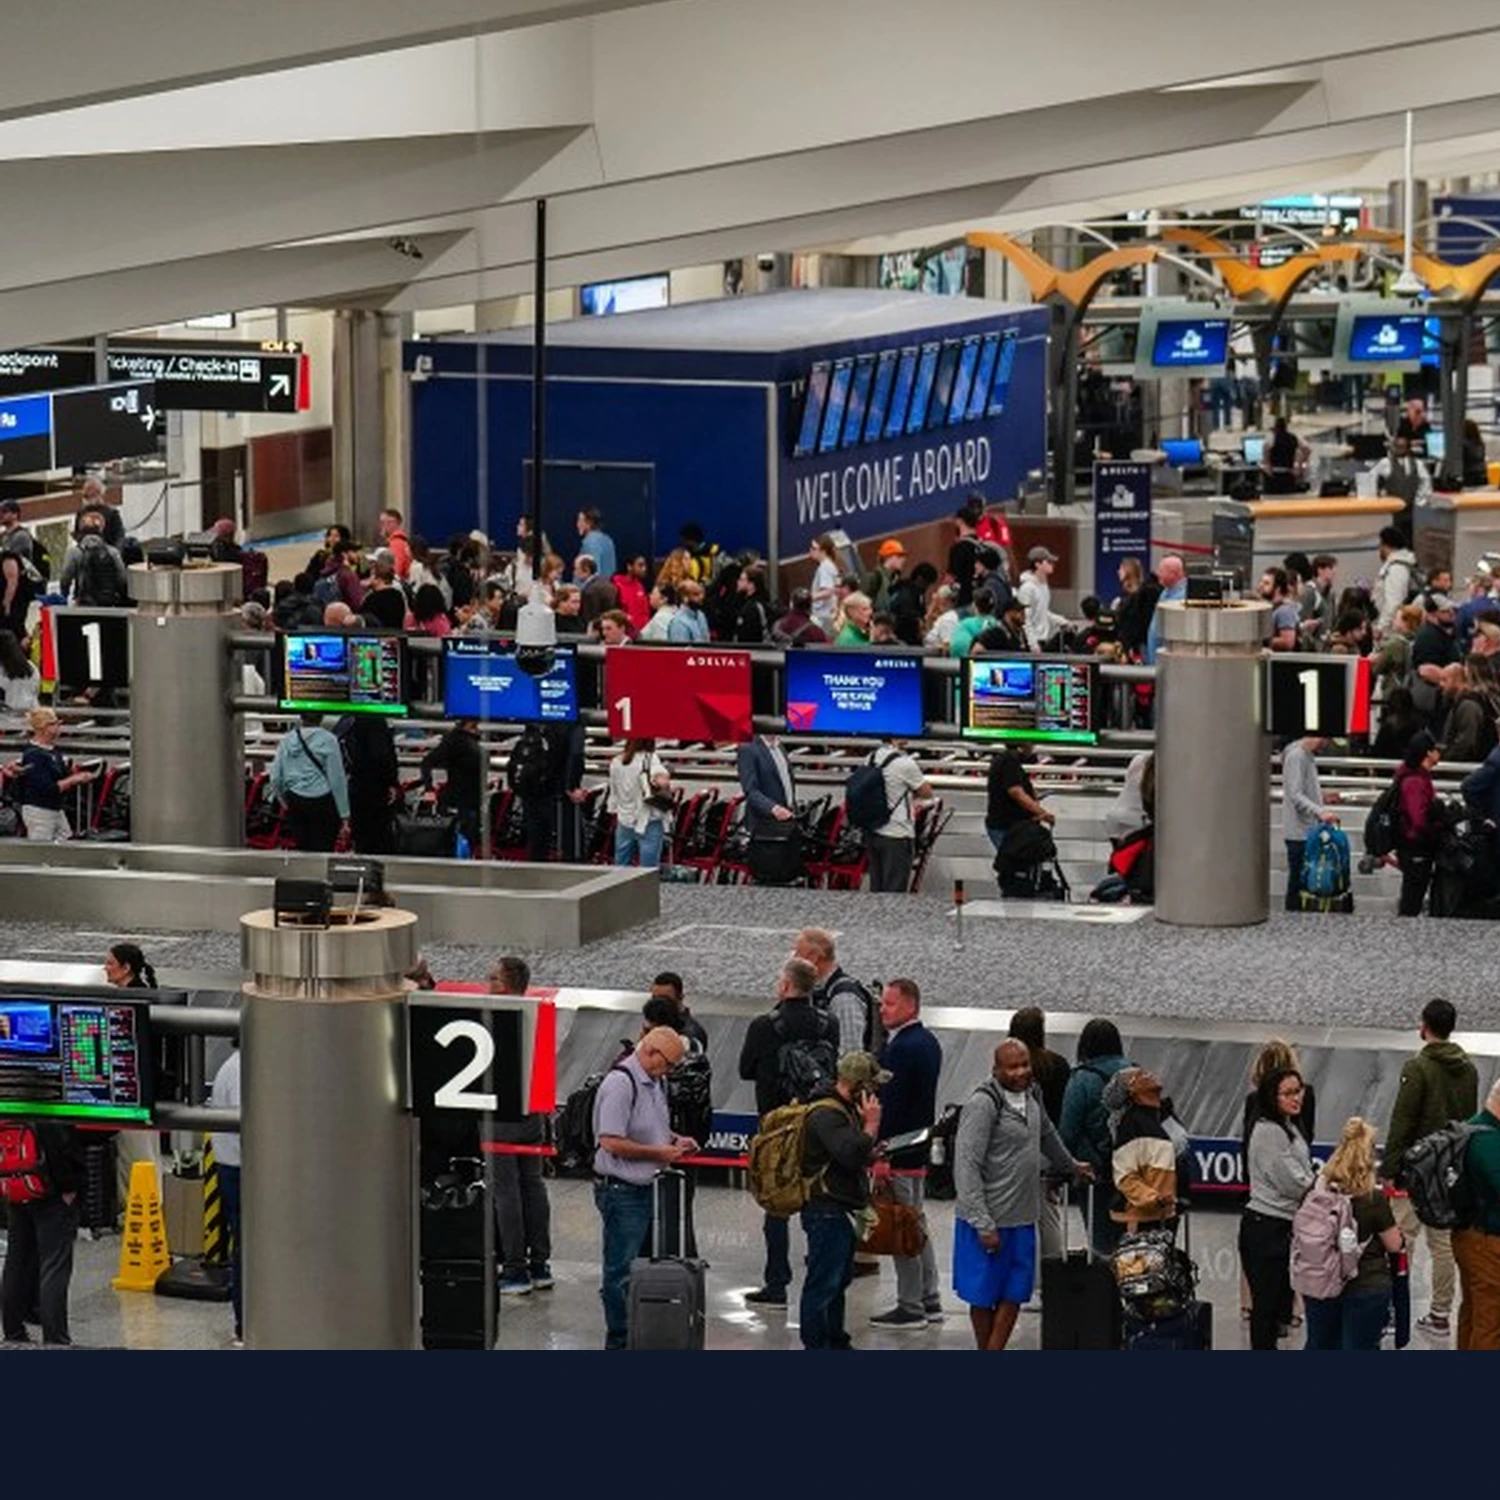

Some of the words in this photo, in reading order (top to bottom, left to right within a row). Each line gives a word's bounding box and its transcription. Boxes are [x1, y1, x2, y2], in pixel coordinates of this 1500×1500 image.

[107, 356, 164, 373] icketing
[796, 456, 903, 525] WELCOME
[909, 437, 991, 498] ABOARD
[82, 622, 102, 680] 1
[697, 656, 736, 667] DELTA
[823, 674, 861, 686] THANK
[862, 676, 886, 688] YOU
[614, 697, 631, 731] 1
[1299, 669, 1319, 731] 1
[434, 1020, 497, 1110] 2
[704, 1132, 749, 1150] AMEX
